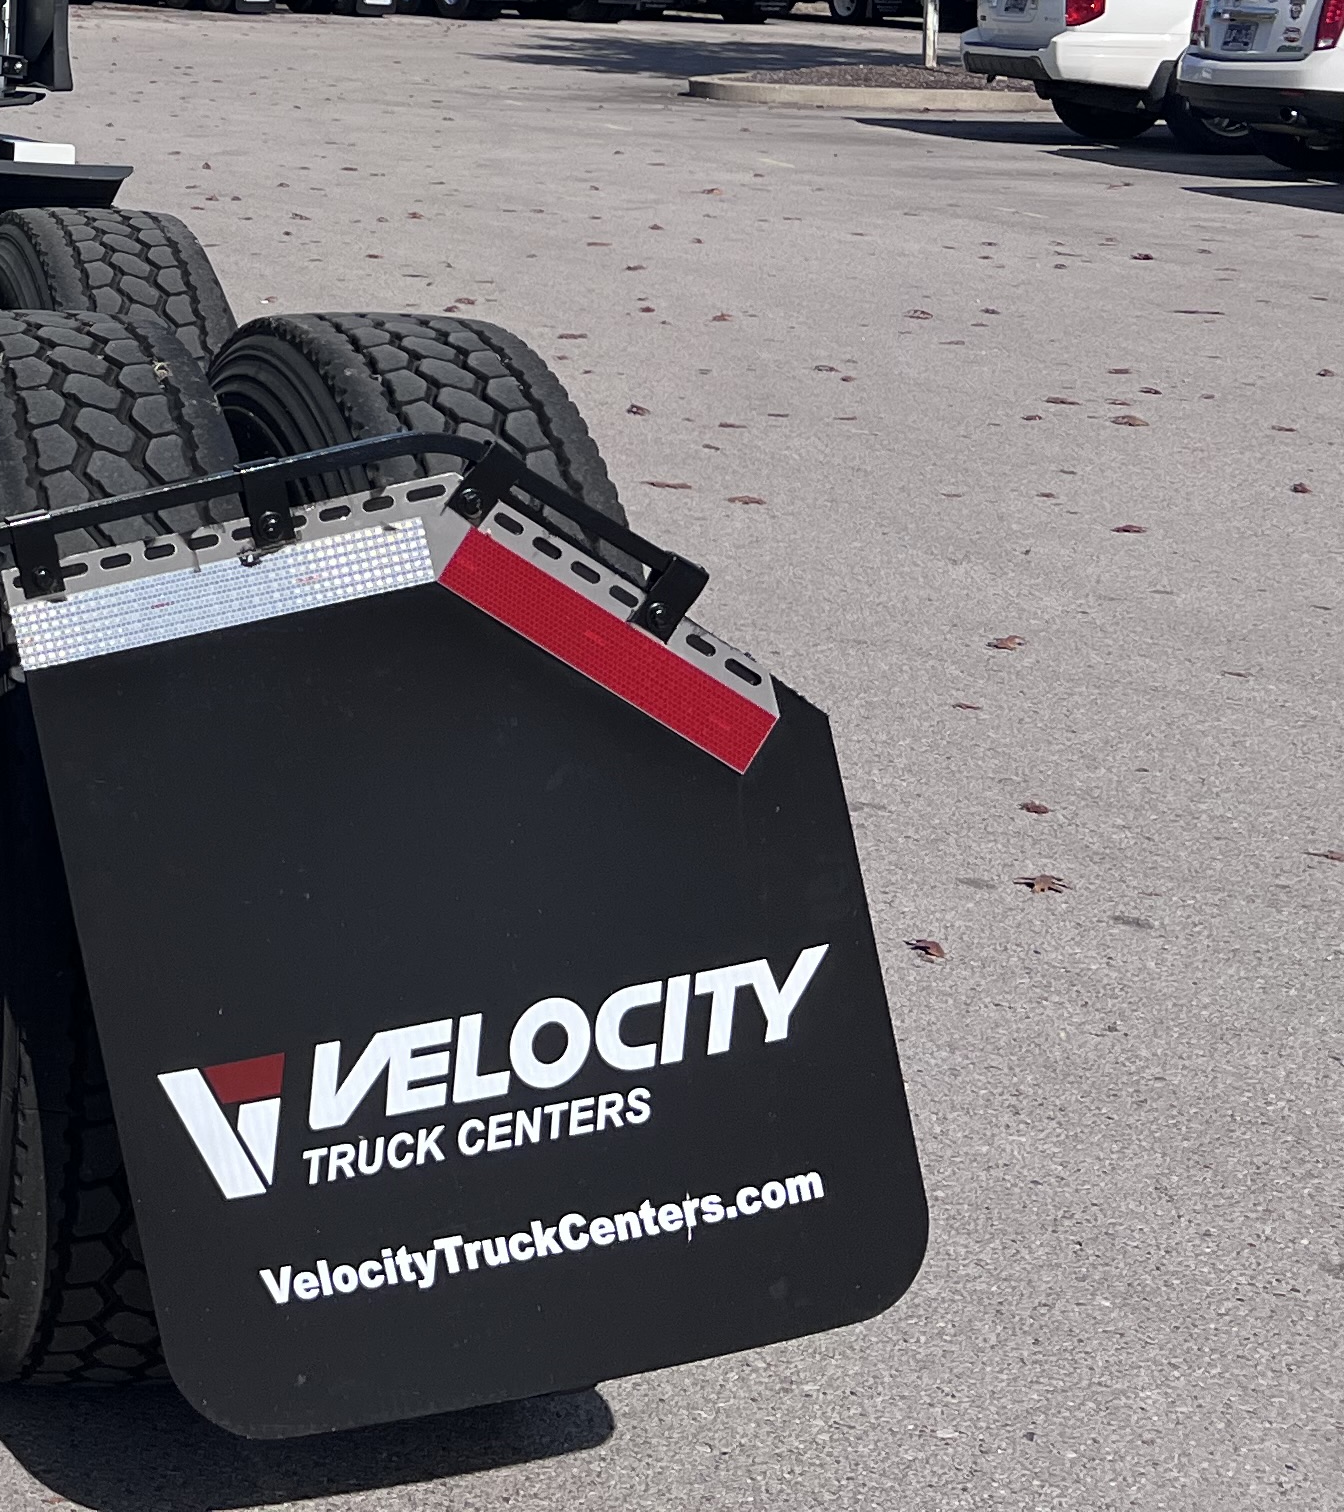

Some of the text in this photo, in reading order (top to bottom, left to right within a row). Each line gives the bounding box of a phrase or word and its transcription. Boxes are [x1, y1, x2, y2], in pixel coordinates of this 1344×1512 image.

[308, 943, 830, 1131] VELOCITY
[303, 1087, 651, 1185] TRUCK CENTERS
[259, 1171, 825, 1305] VelocityTruckCenters.com
